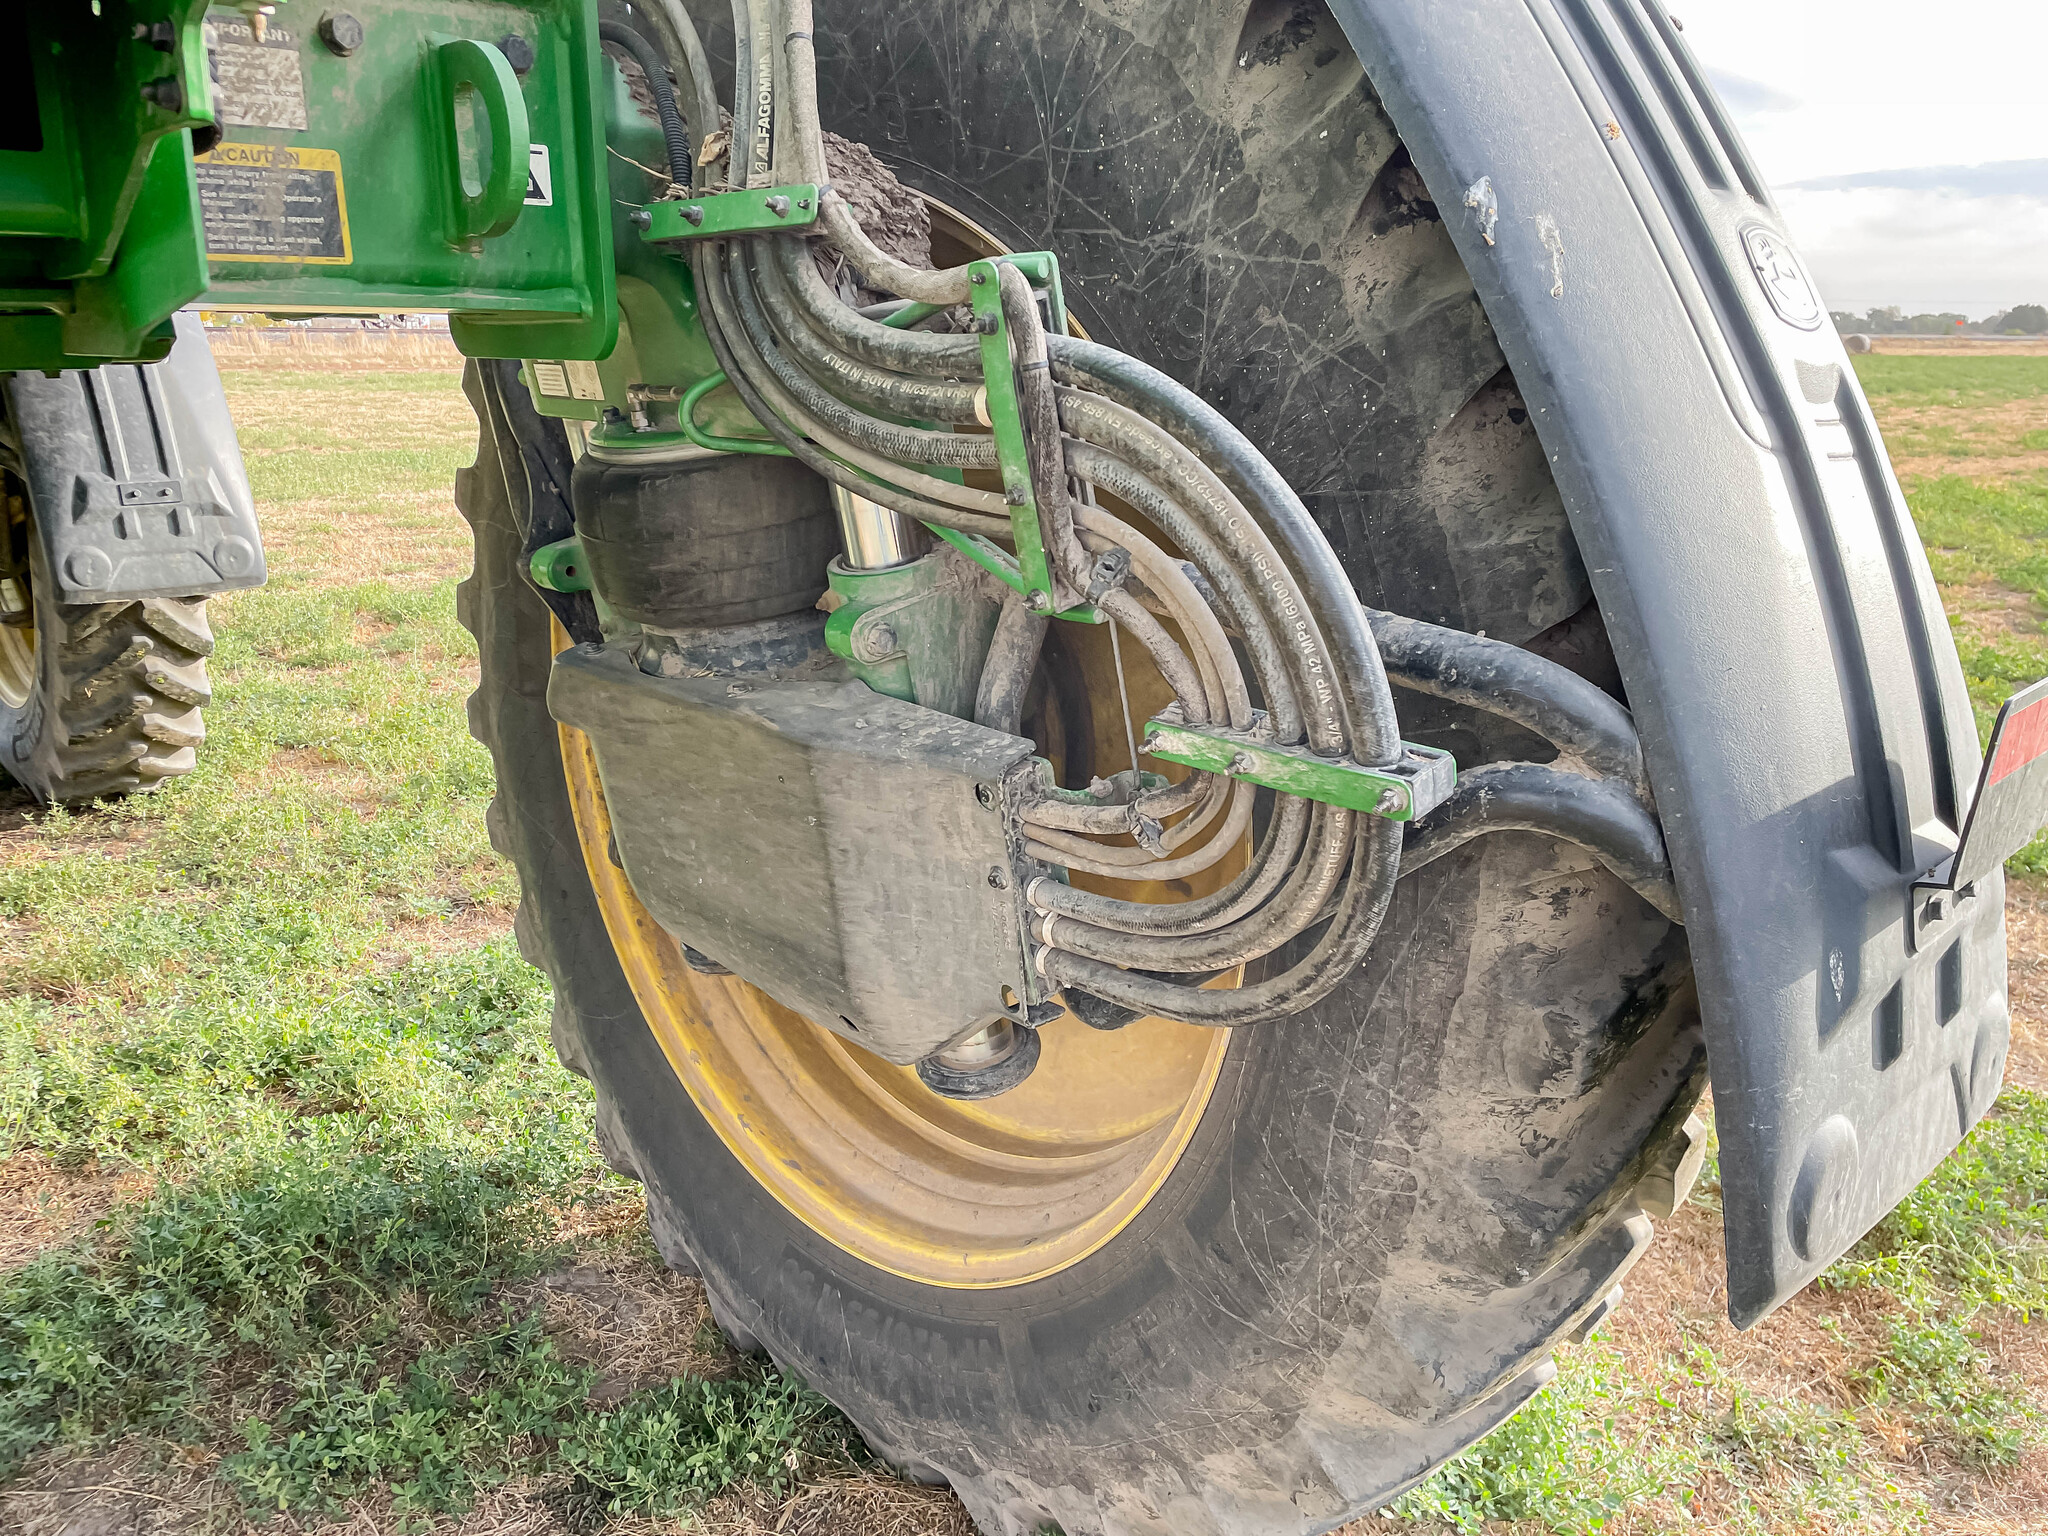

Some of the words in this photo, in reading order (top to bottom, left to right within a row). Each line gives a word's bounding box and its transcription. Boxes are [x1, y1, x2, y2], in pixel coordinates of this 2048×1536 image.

[756, 54, 772, 161] ALFAGOMMA
[821, 352, 850, 374] ITALY
[849, 365, 863, 379] IN
[862, 371, 893, 389] MADE
[1058, 393, 1082, 409] 4SH
[1081, 400, 1105, 418] 856
[1103, 410, 1124, 428] EN
[1123, 421, 1173, 460] exceeds
[1251, 550, 1278, 580] PSI)
[1271, 579, 1300, 619] (6000
[1293, 620, 1316, 654] MPa
[1309, 655, 1324, 674] 42
[1315, 676, 1334, 704] WP
